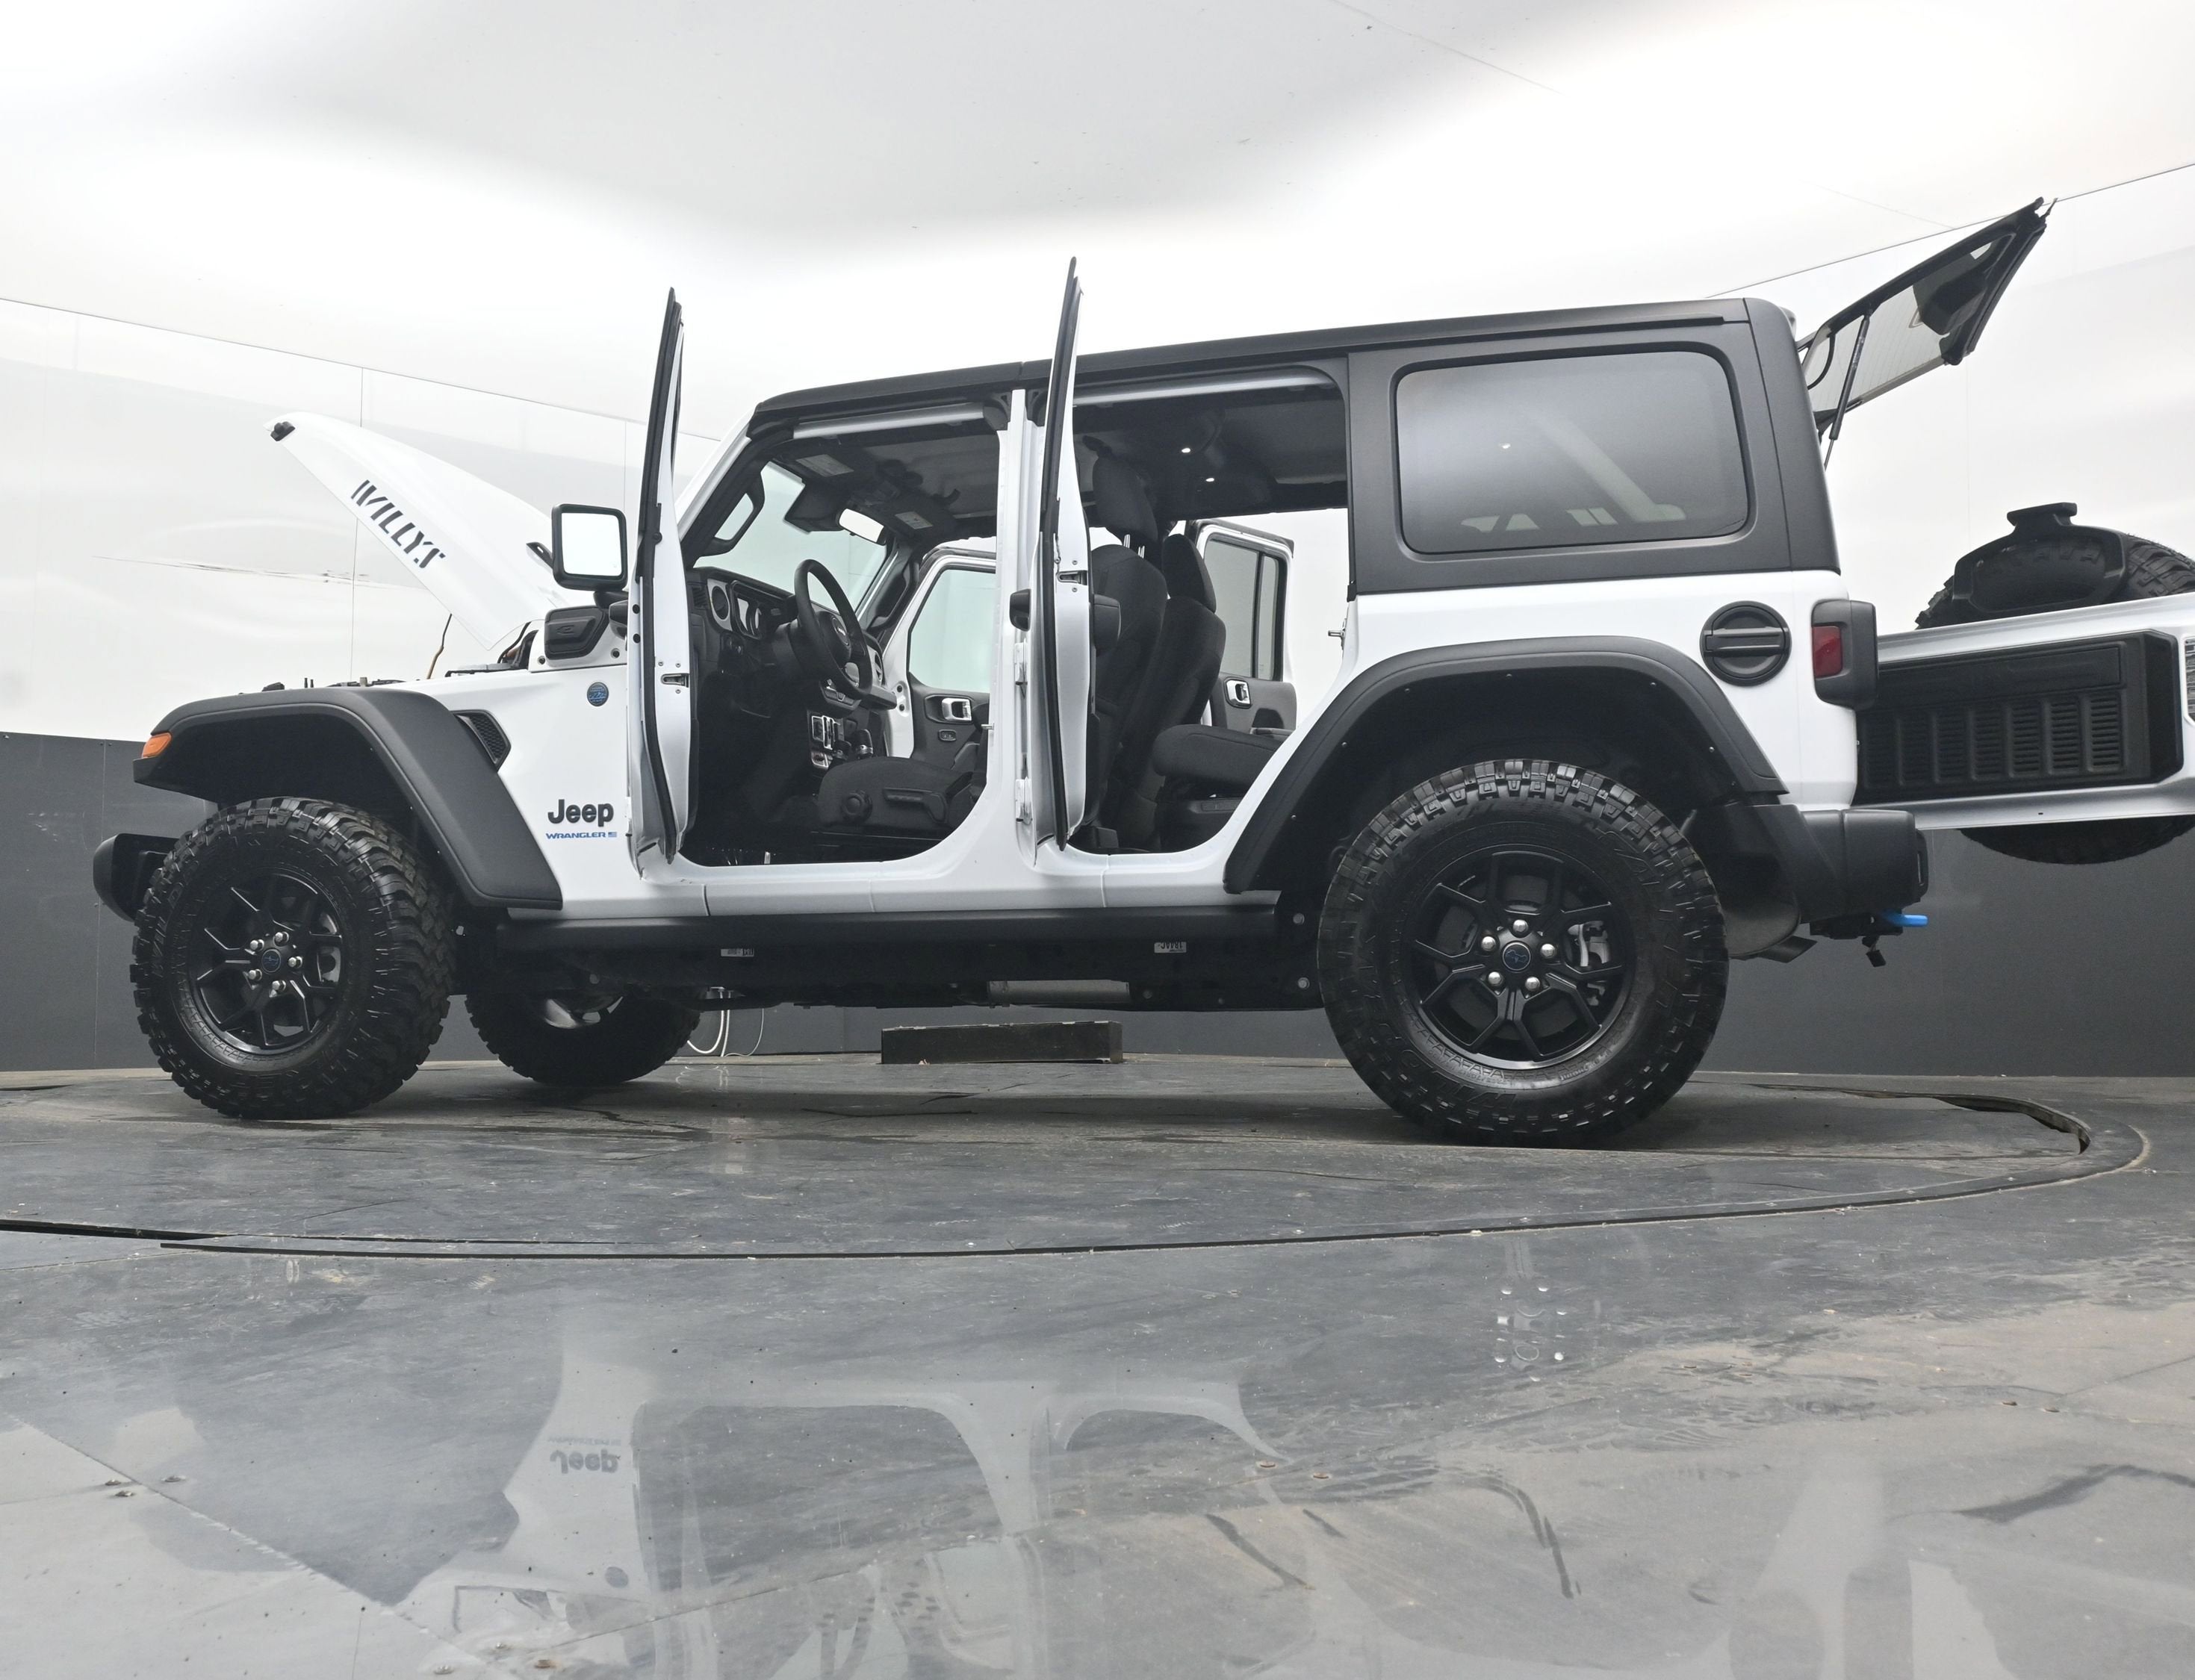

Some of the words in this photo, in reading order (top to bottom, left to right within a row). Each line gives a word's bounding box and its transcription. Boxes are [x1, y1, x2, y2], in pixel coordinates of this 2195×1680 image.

[351, 479, 446, 568] WILLYS
[547, 799, 615, 827] Jeep
[546, 831, 606, 839] WRANGLER
